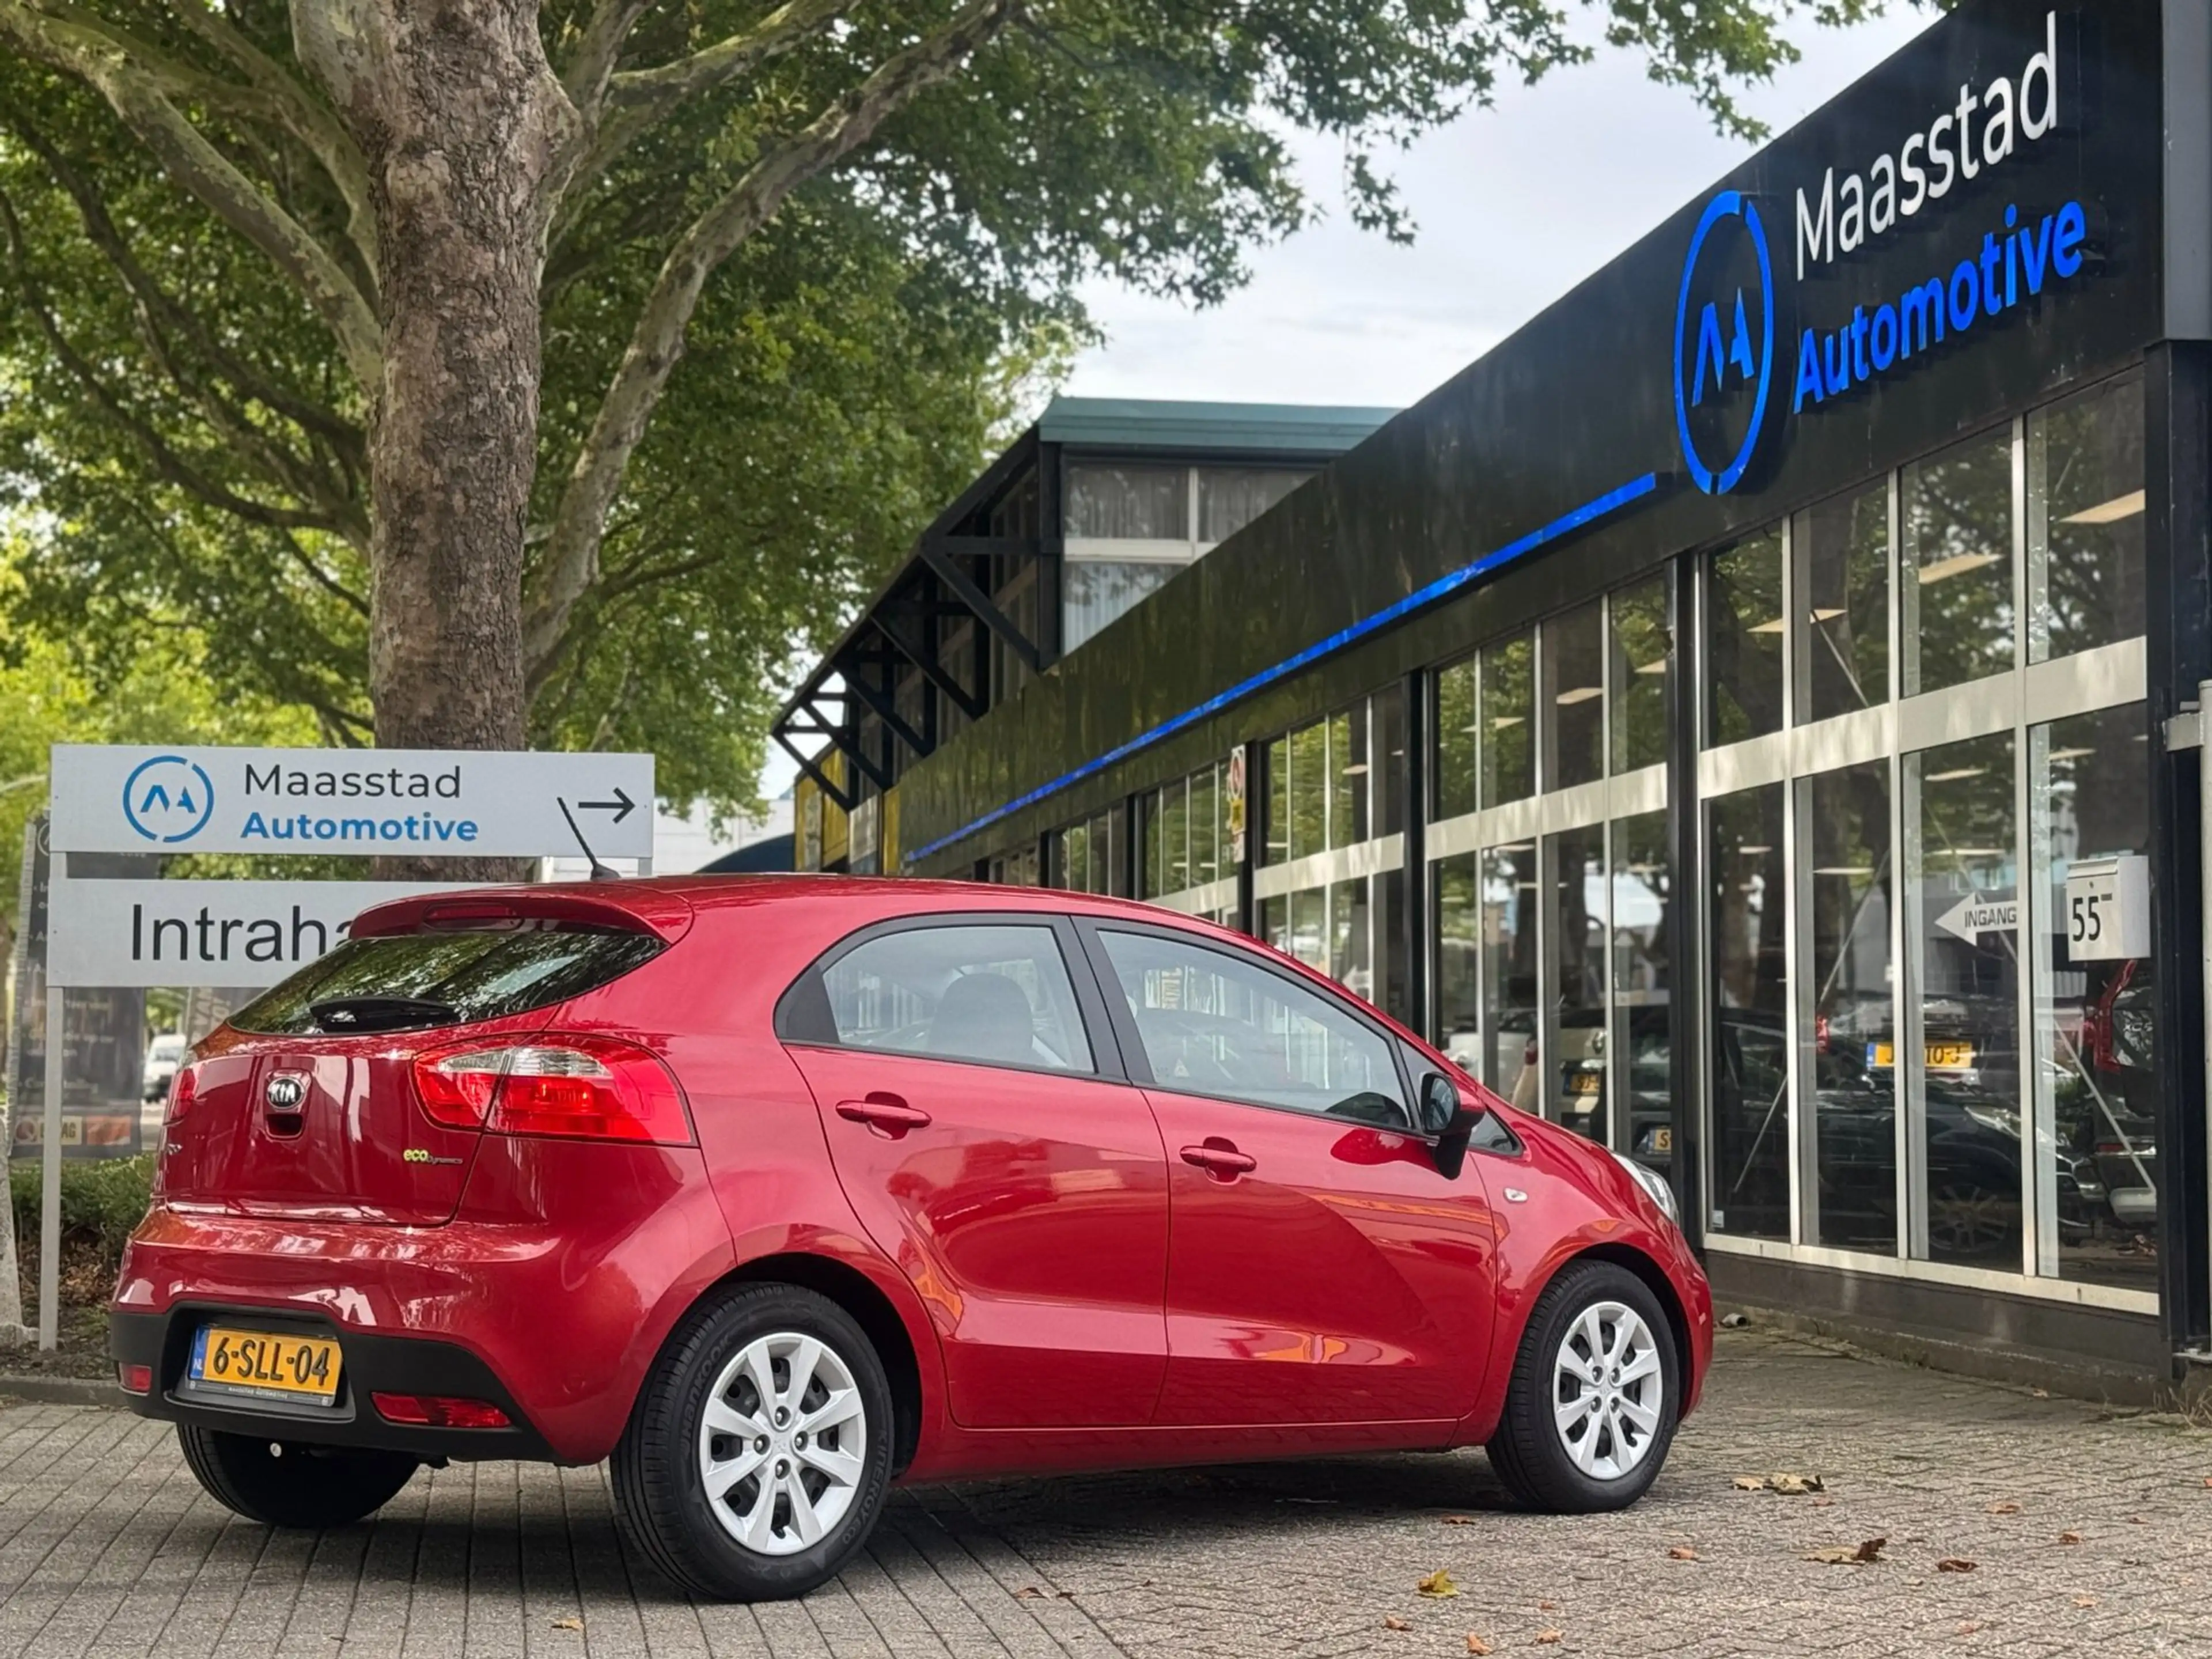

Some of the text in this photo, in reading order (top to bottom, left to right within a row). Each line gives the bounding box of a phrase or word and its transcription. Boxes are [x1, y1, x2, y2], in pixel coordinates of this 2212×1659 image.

[1796, 10, 2057, 282] Maasstad
[1793, 200, 2086, 415] Automotive
[245, 764, 461, 799] Maasstad
[240, 812, 479, 841] Automotive
[1964, 907, 2017, 927] INGANG
[2072, 896, 2101, 942] 55
[270, 1084, 296, 1103] KIA
[213, 1336, 330, 1386] 6-SLL-04
